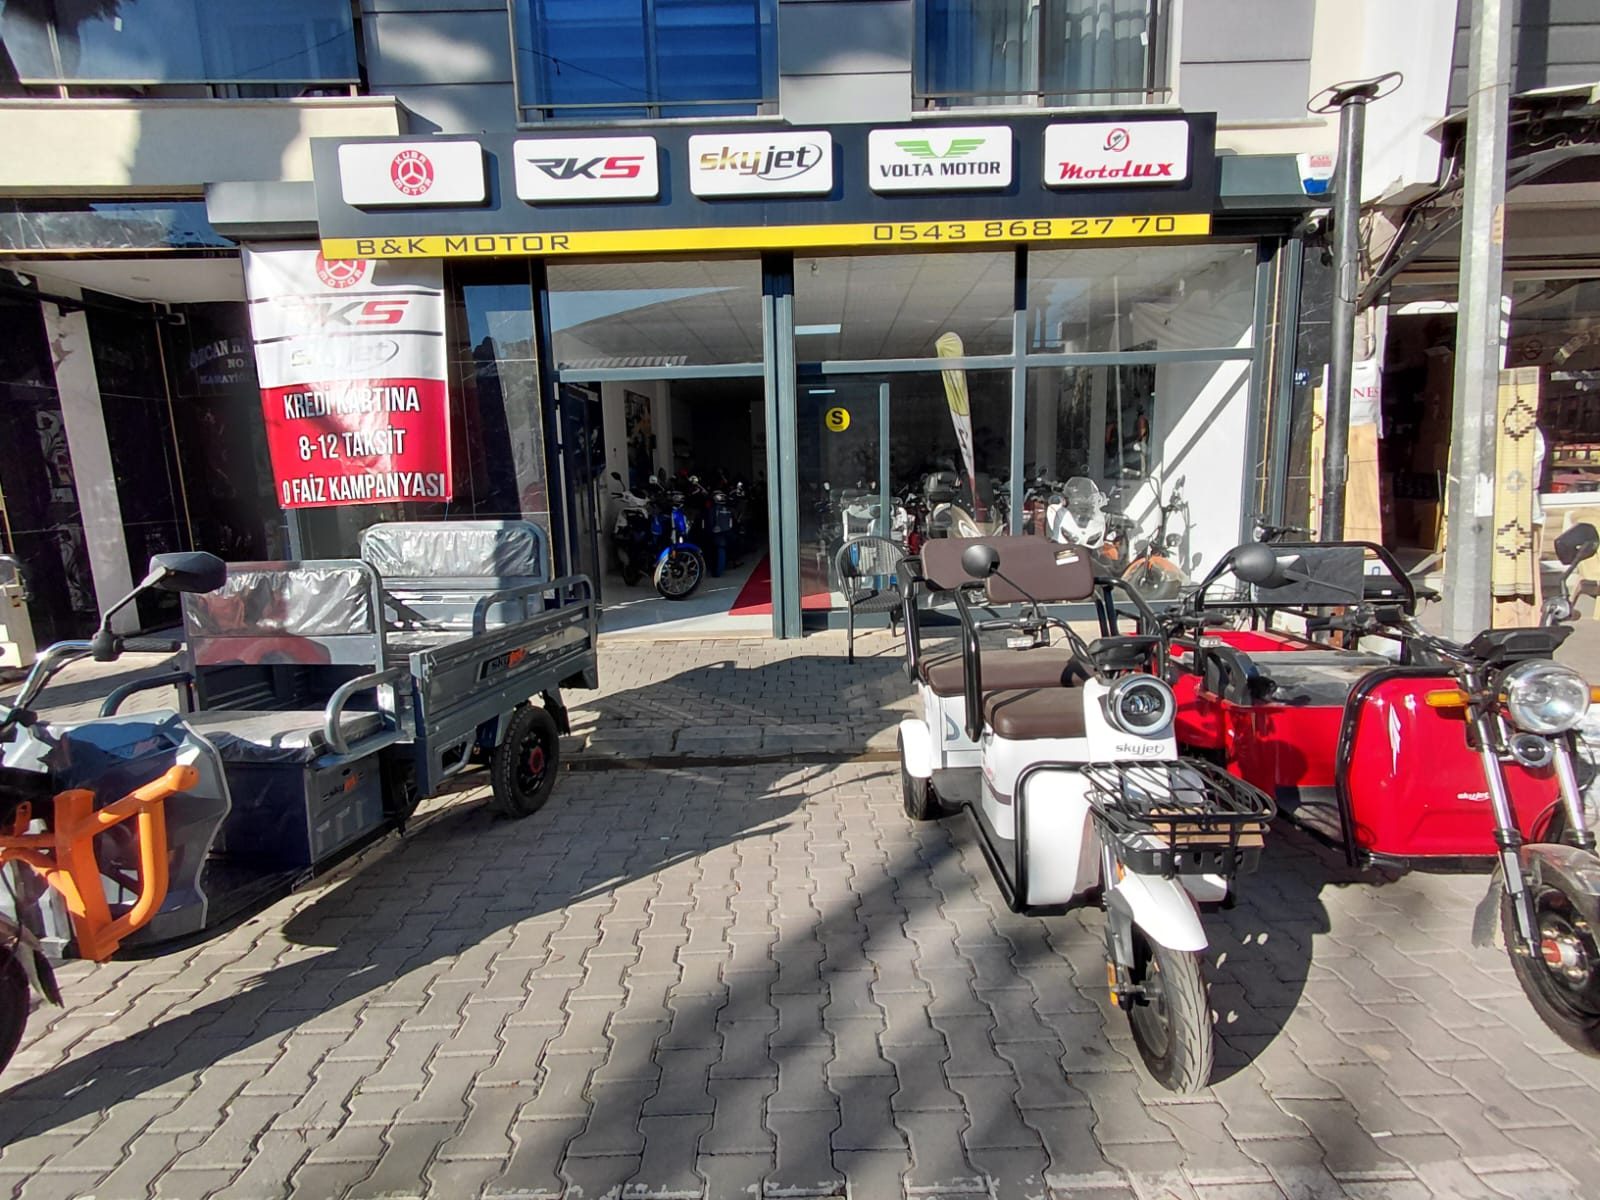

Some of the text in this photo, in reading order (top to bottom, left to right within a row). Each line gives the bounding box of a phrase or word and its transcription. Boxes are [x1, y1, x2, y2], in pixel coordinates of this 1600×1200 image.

[395, 151, 426, 164] KUBA
[526, 156, 645, 180] RKS
[700, 145, 811, 176] skyjet
[880, 161, 1001, 178] VOLTA MOTOR
[394, 178, 432, 195] MOTOR
[873, 216, 1176, 241] 0543 868 27 70
[356, 235, 570, 256] B&K MOTOR
[319, 268, 363, 288] MOTOR
[282, 300, 409, 327] KS
[284, 391, 332, 420] KREDİ
[831, 410, 844, 425] S
[299, 425, 406, 461] 8-12 TAKSİT
[292, 474, 327, 504] FAİZ
[328, 472, 445, 502] KAMPANYASI
[1115, 744, 1161, 756] skyjet
